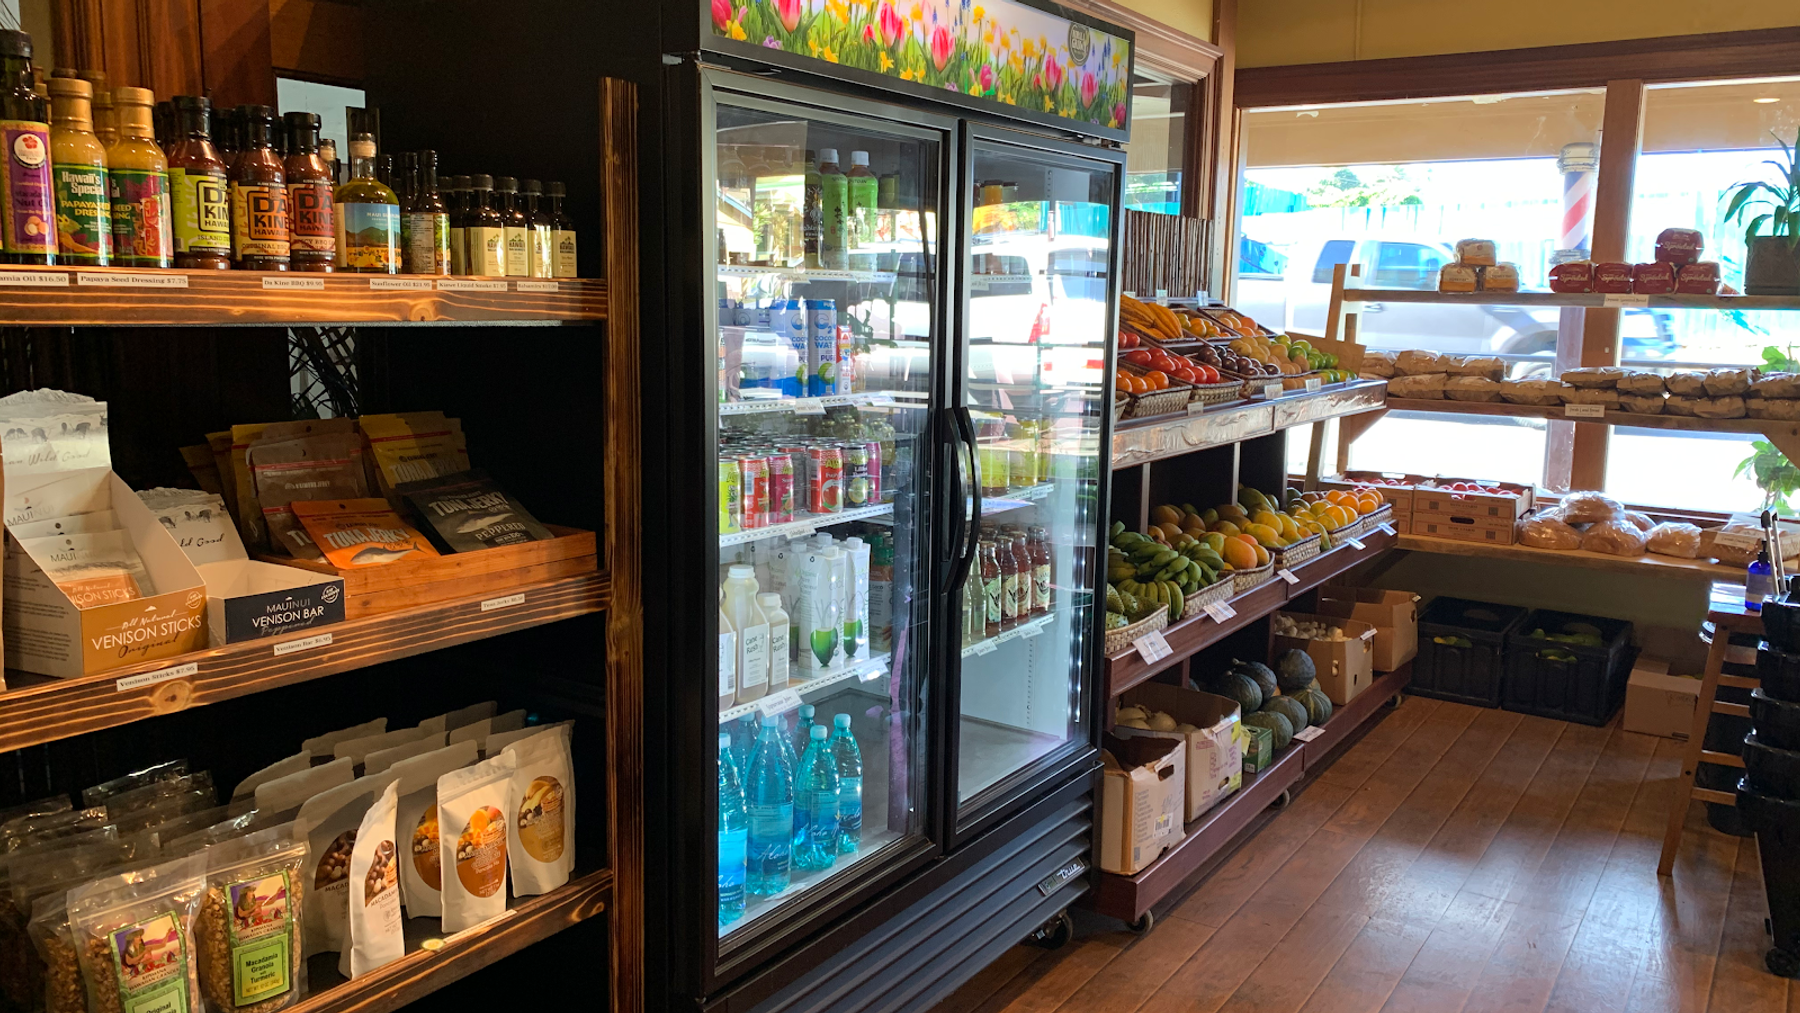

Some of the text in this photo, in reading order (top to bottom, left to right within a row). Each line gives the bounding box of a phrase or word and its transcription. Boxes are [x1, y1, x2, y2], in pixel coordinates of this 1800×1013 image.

[62, 171, 101, 185] Hawaii's
[61, 200, 98, 209] PAPAYA
[253, 196, 288, 213] DA
[298, 193, 334, 210] DA
[204, 205, 229, 219] KIN
[300, 210, 334, 226] KINE
[204, 220, 229, 228] HAWAI
[254, 214, 289, 230] KINE
[1663, 241, 1694, 250] Sprouted
[1560, 273, 1588, 282] Sprouted
[1640, 272, 1669, 282] Sprouted
[1680, 273, 1712, 282] Sprouted
[428, 498, 472, 517] TUNA
[469, 491, 509, 510] JERKY
[323, 526, 411, 550] TUNA JERKY
[475, 522, 526, 541] PEPPERED
[196, 532, 225, 547] Good
[104, 587, 136, 600] STICKS
[266, 598, 311, 614] MAUINUI
[121, 610, 176, 630] All Natural
[252, 606, 325, 628] VENISON BAR
[92, 614, 202, 650] VENISON STICKS
[772, 634, 784, 644] Cane
[118, 632, 180, 659] Original
[276, 641, 302, 652] Venison
[746, 636, 758, 646] Cane
[120, 665, 195, 688] Venison Sticks $7.95
[325, 883, 348, 892] MACAD
[370, 888, 398, 907] MACADAM
[246, 952, 278, 967] Macadamia
[251, 962, 274, 973] Granola
[250, 971, 275, 984] Turmeric
